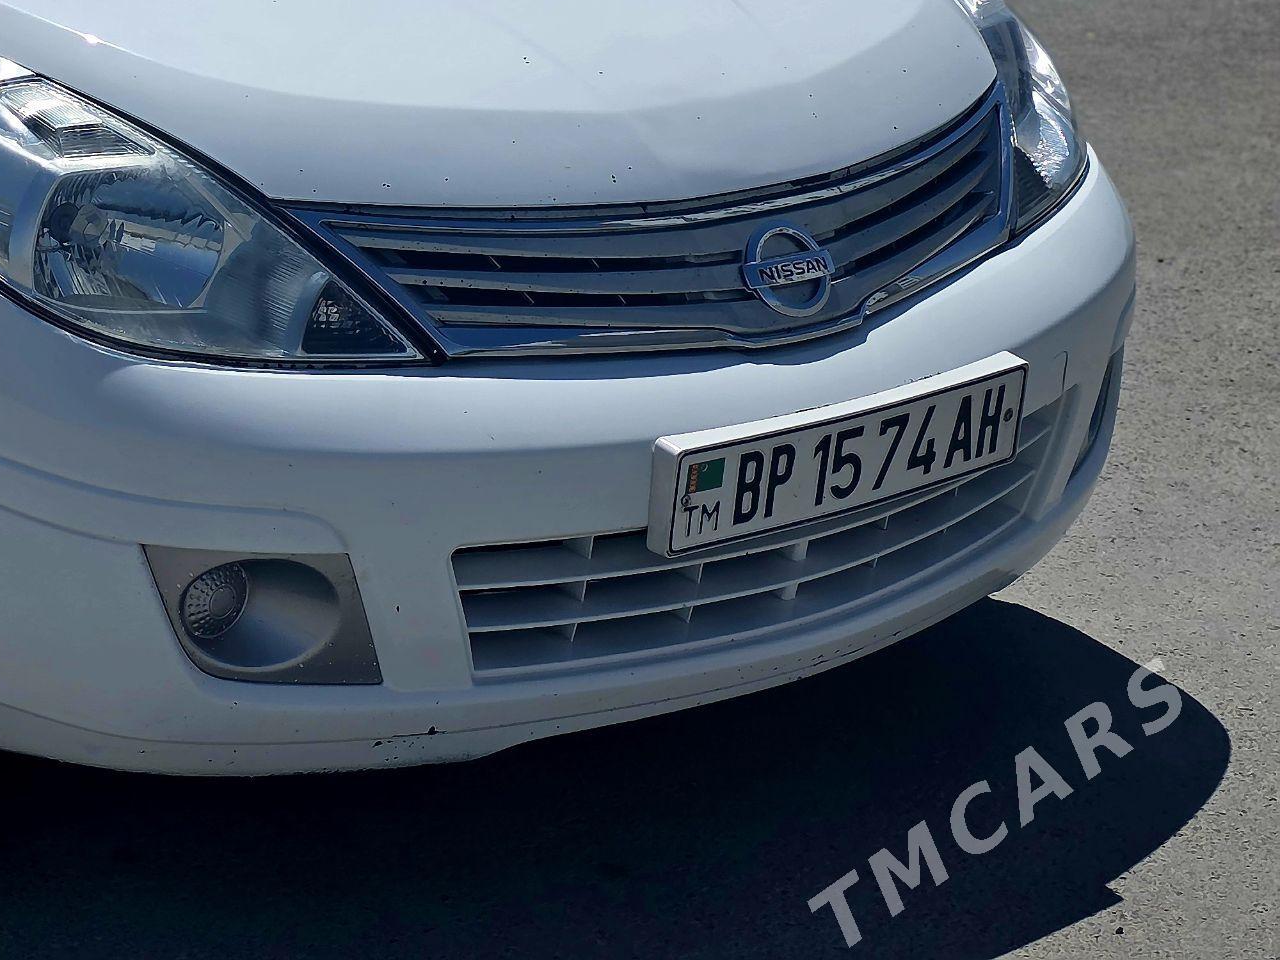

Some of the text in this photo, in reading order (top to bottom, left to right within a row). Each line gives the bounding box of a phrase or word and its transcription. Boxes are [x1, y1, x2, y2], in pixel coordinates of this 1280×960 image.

[758, 256, 830, 284] NISSAN
[732, 384, 1006, 526] BP 1574 AH
[683, 500, 721, 537] TM
